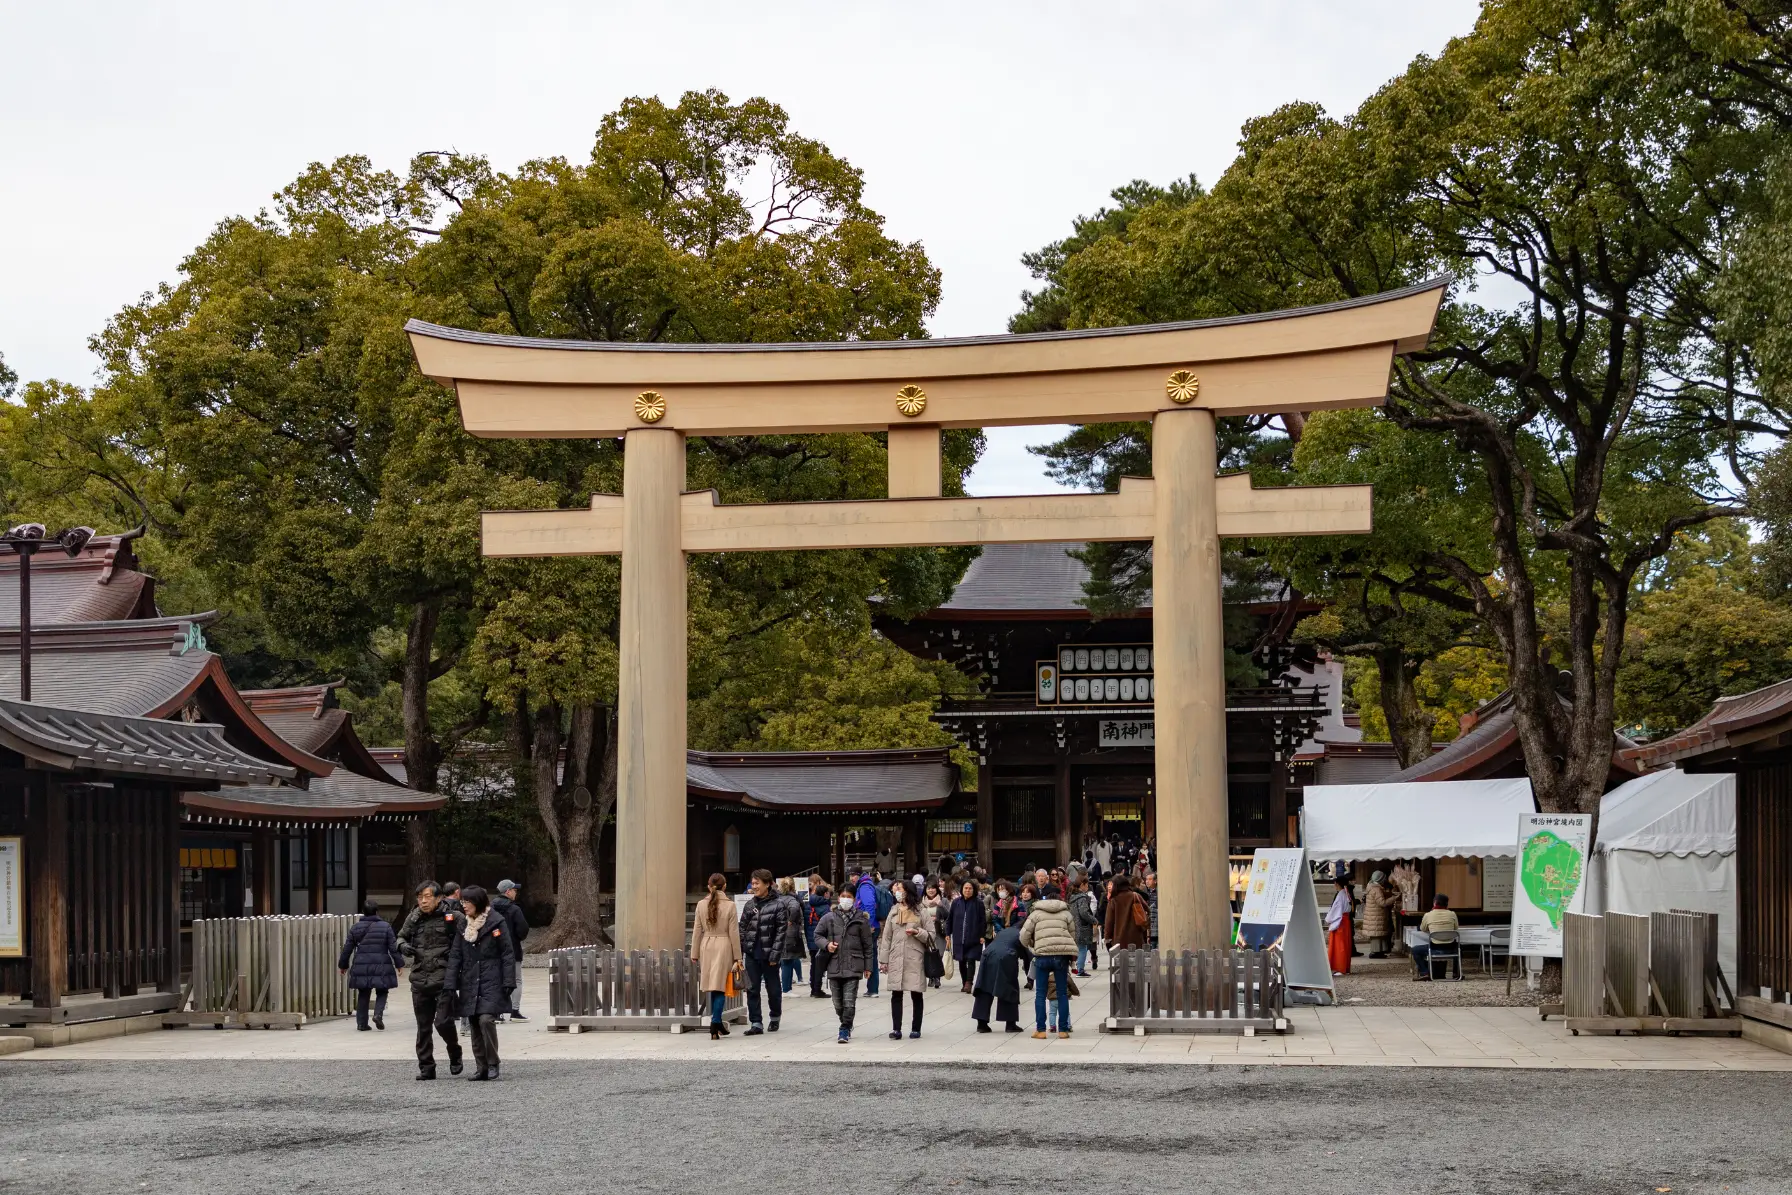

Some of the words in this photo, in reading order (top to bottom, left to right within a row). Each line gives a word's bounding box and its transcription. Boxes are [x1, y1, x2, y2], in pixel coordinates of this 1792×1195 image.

[1063, 684, 1154, 694] 令和2年11
[1103, 721, 1154, 741] 南神門
[1530, 817, 1583, 827] 明治神宮境内図
